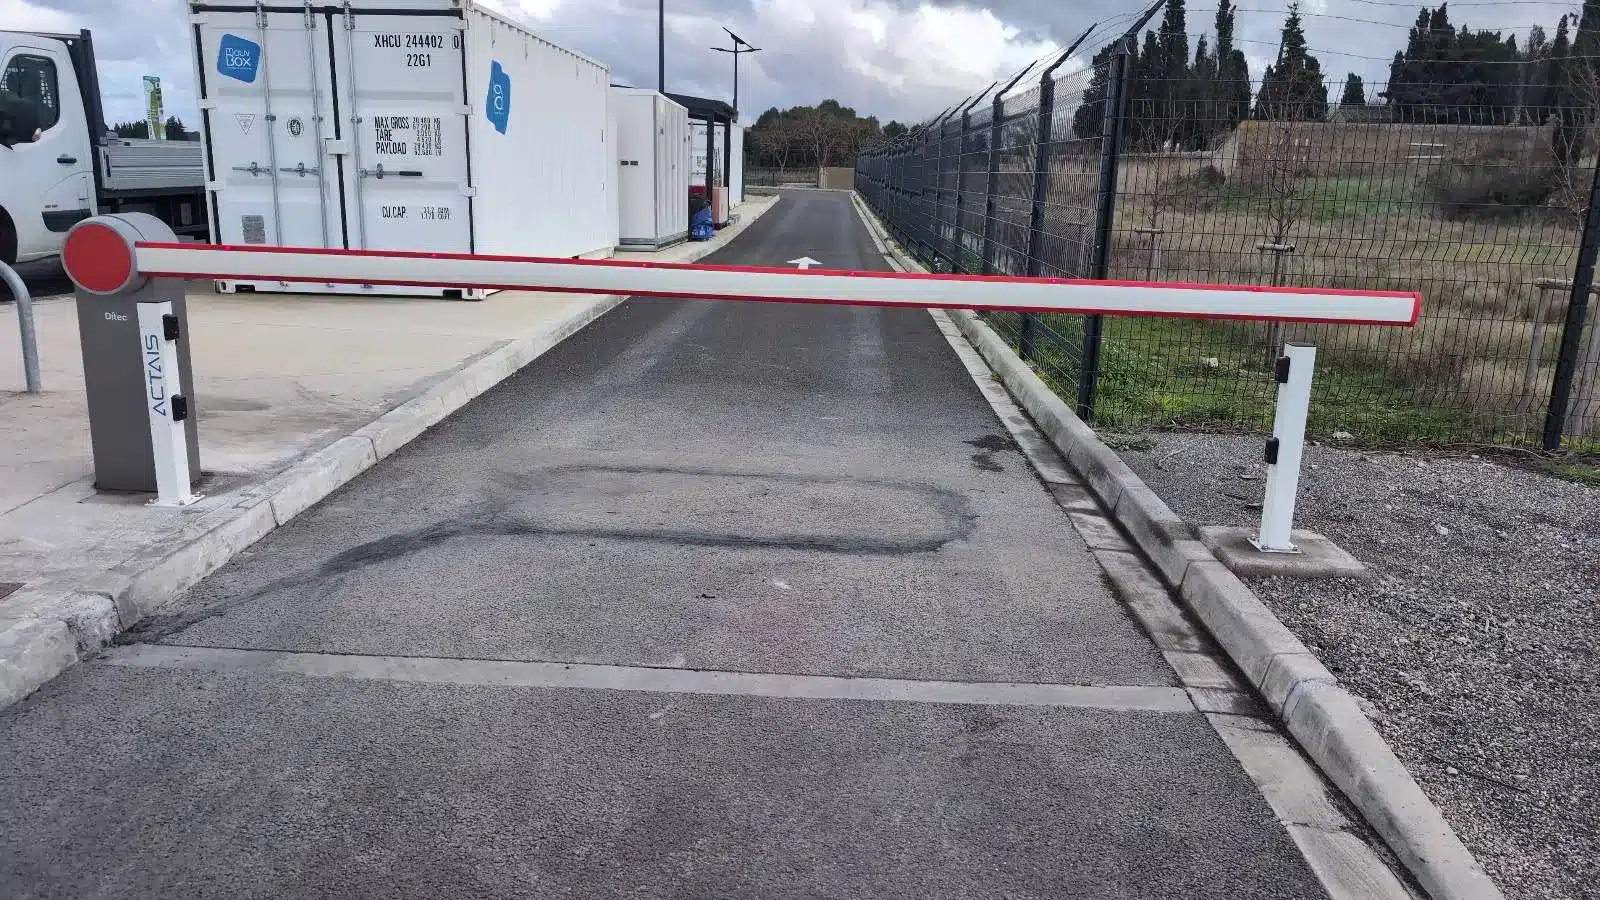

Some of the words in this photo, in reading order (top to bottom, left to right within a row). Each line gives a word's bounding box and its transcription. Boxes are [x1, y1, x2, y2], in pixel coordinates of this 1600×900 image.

[374, 34, 401, 48] XHCU
[405, 34, 443, 48] 244402
[226, 55, 252, 67] BOX
[406, 53, 431, 67] 22G1
[374, 116, 389, 129] MAX
[390, 116, 410, 129] GROSS
[375, 129, 393, 141] TARE
[375, 142, 407, 155] PAYLOAD
[104, 311, 128, 321] Ditec
[145, 334, 167, 416] ACTAIS
